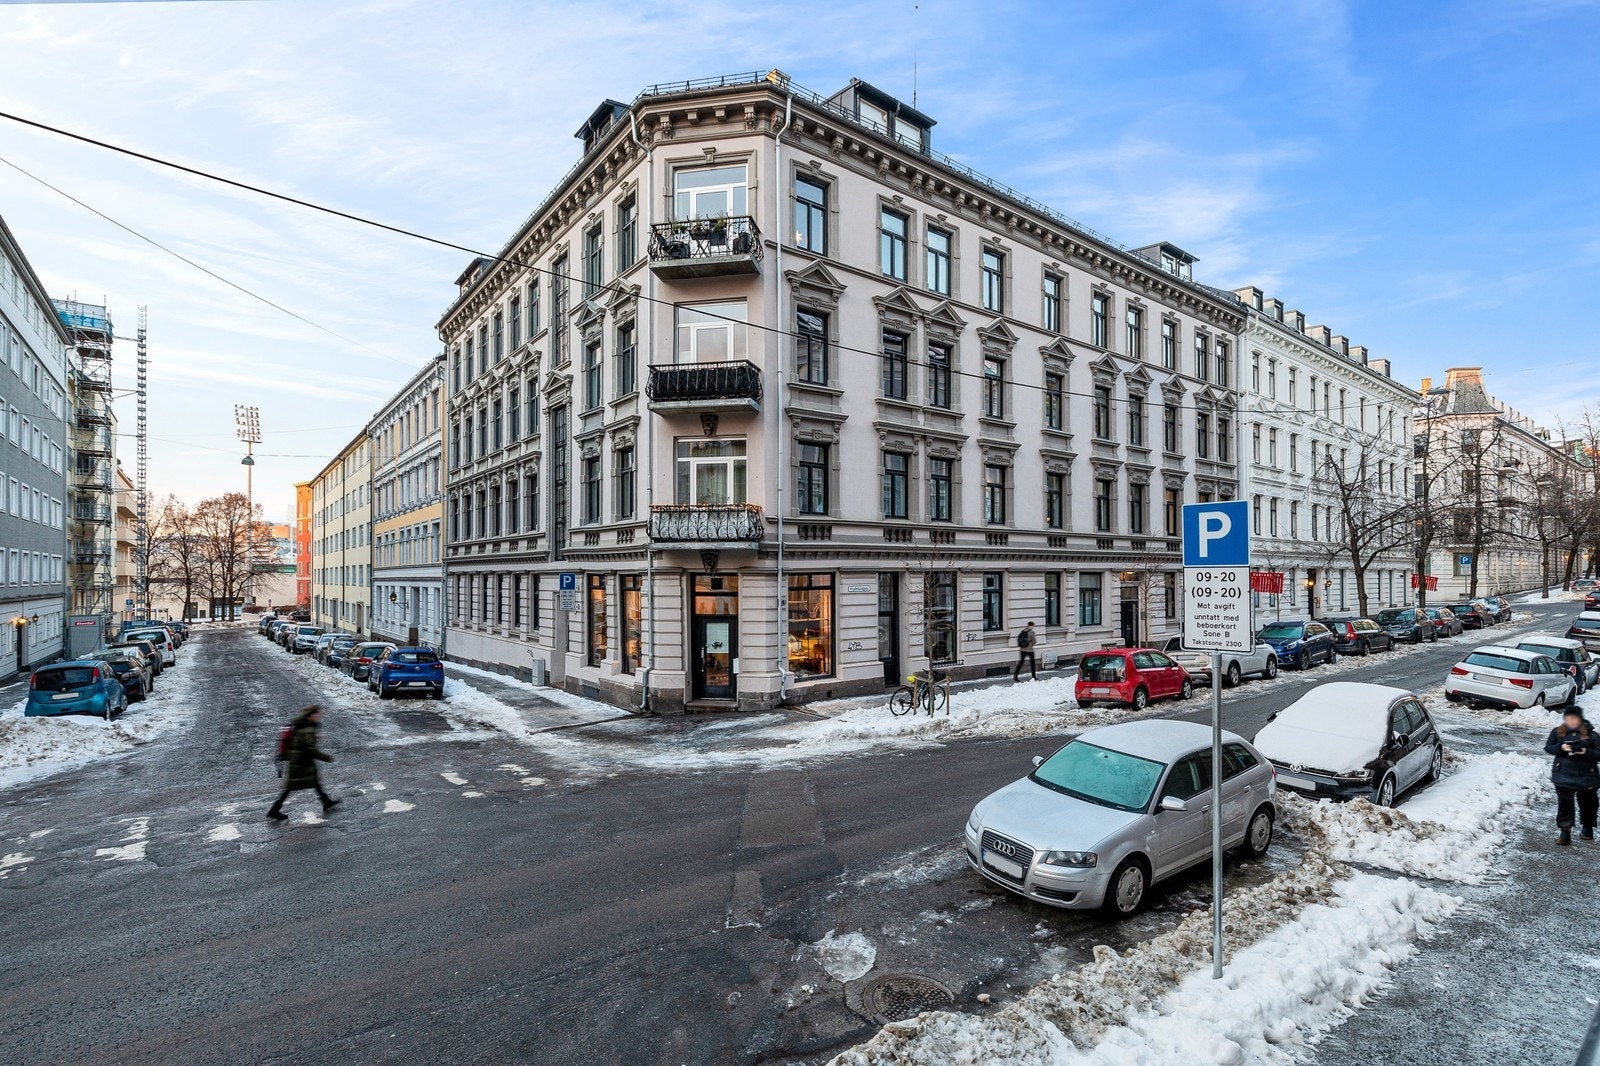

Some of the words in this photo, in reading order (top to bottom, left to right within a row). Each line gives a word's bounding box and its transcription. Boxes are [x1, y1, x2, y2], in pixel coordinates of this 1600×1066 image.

[1199, 511, 1231, 557] P
[563, 575, 571, 587] P
[1196, 572, 1236, 582] 09-20
[1191, 587, 1242, 599] (09-20)
[1197, 602, 1211, 610] Mot
[1214, 602, 1236, 612] avgift
[1223, 614, 1239, 622] med
[1196, 622, 1237, 630] beboerkort
[1203, 630, 1221, 638] Sone
[1192, 639, 1223, 647] Takstsone
